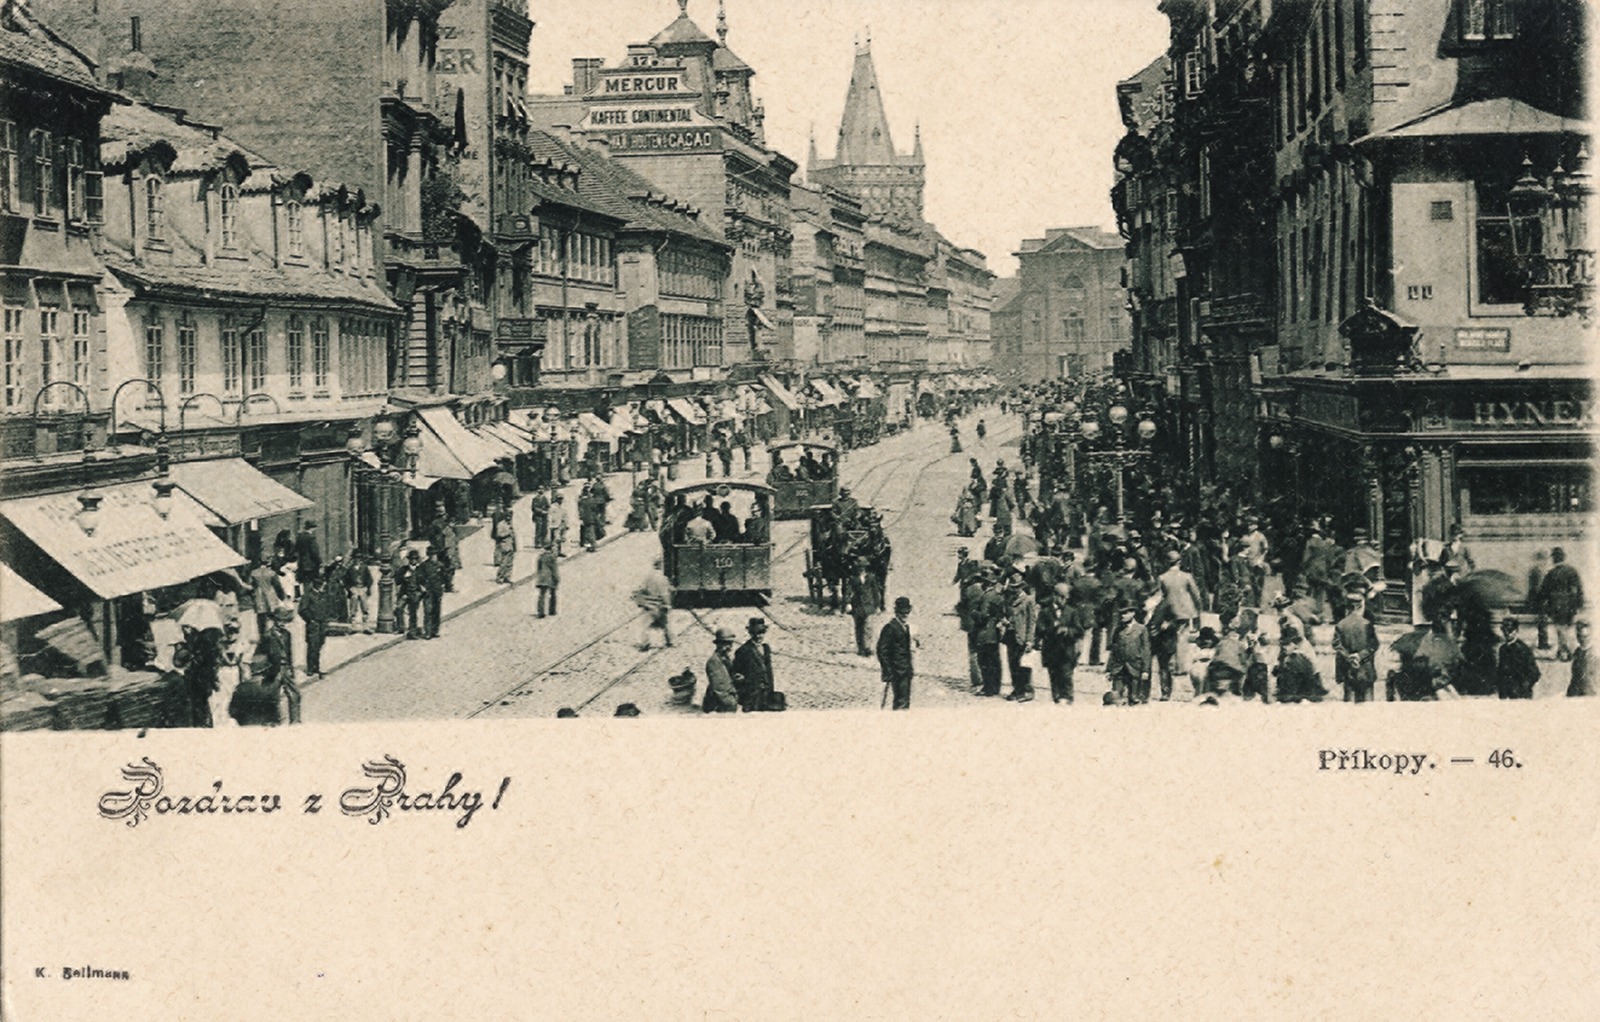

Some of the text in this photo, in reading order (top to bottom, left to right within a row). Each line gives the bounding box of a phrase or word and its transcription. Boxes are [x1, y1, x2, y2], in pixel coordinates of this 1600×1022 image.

[605, 77, 678, 92] MERCUR
[591, 108, 692, 124] KAFFEE CONTINENTAL
[669, 131, 711, 149] CACAO
